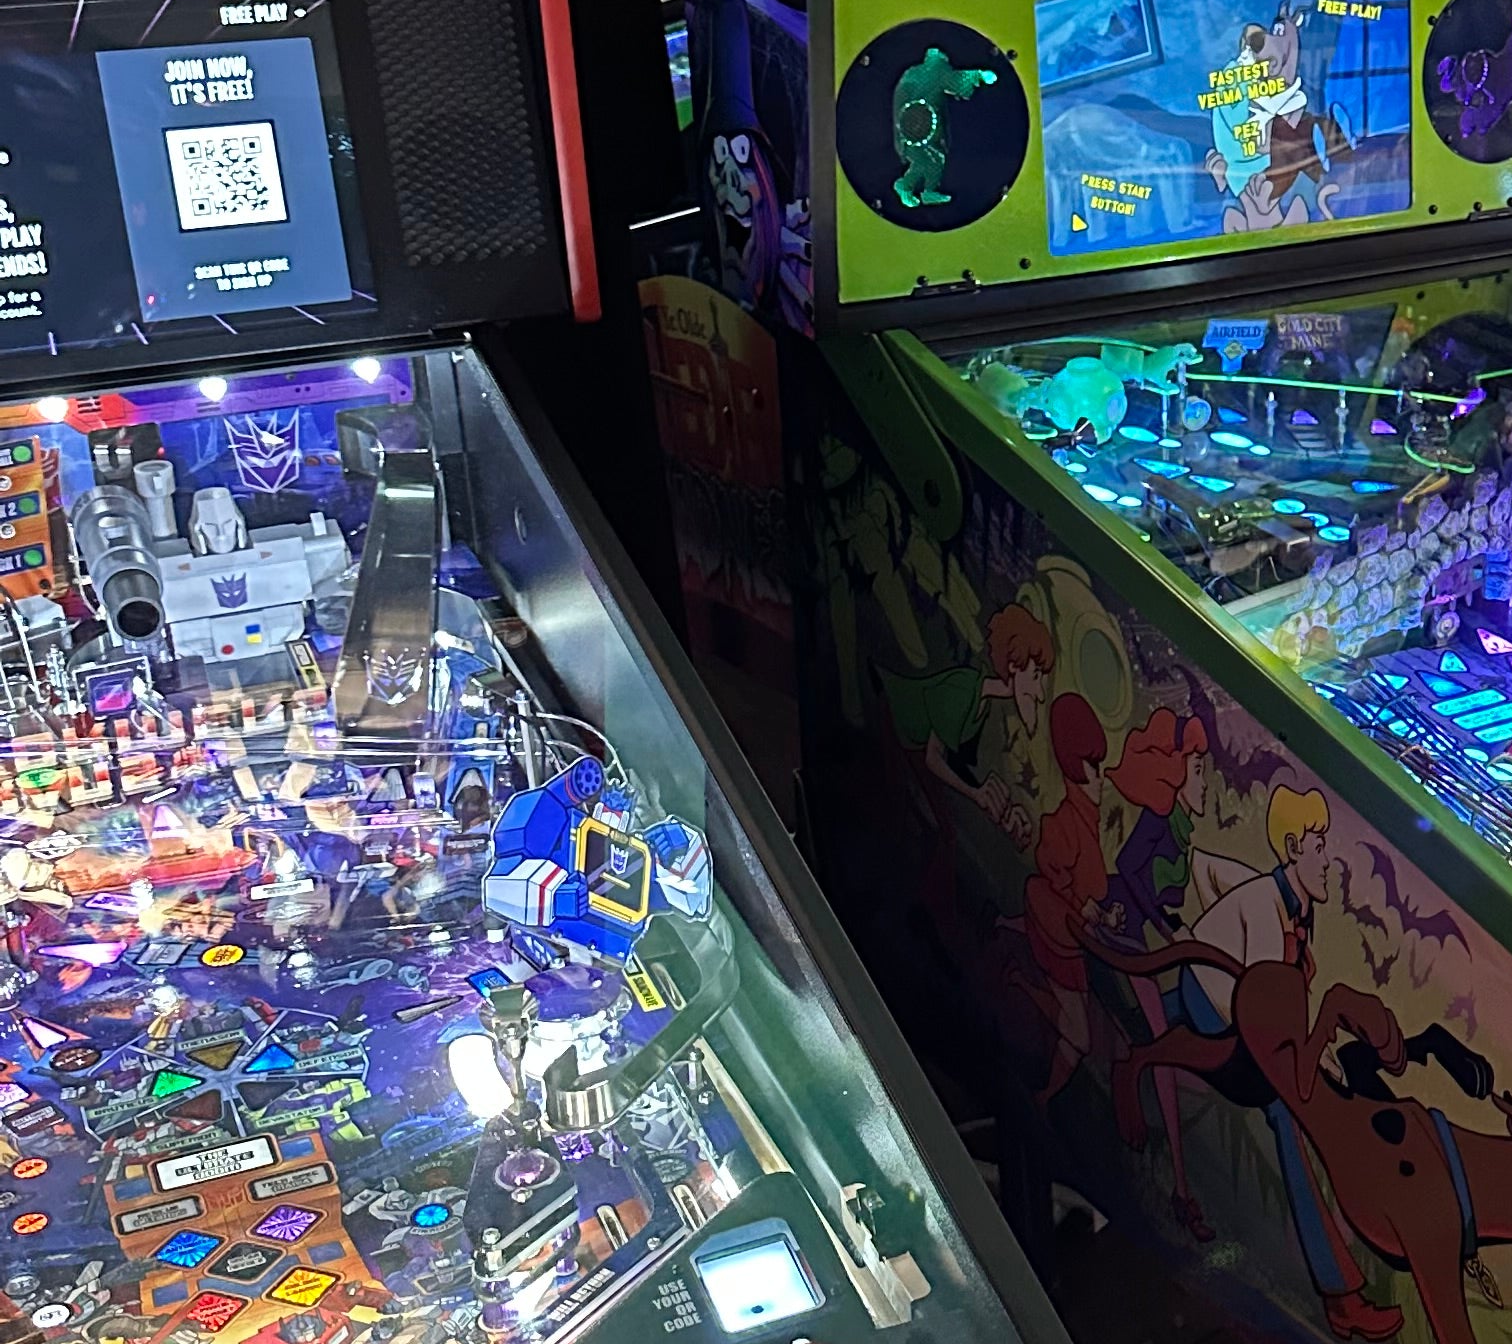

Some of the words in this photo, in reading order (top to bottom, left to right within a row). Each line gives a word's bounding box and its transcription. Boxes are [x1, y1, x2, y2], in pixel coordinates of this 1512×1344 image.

[219, 4, 253, 25] FREE
[253, 2, 289, 23] PLAY
[1348, 2, 1383, 21] PLAY!
[164, 59, 205, 83] JOIN
[206, 55, 254, 81] NOW,
[1208, 59, 1270, 88] FASTEST
[170, 83, 206, 106] IT'S
[207, 77, 255, 103] FREE!
[1197, 84, 1246, 111] VELMA
[1246, 77, 1286, 101] MODE
[1232, 121, 1260, 140] PEZ
[1240, 140, 1257, 157] 10
[1080, 173, 1117, 193] PRESS
[1117, 181, 1153, 200] START
[1090, 196, 1137, 216] BUTTON!
[0, 223, 42, 249] PLAY
[195, 264, 222, 280] SCAN
[223, 261, 247, 277] THIS
[248, 260, 263, 275] QR
[263, 258, 290, 273] CODE
[216, 277, 231, 291] TO
[232, 275, 256, 290] SIGN
[257, 273, 273, 287] UP
[7, 291, 31, 305] for
[32, 292, 42, 303] a
[678, 307, 708, 339] Olde
[1211, 325, 1262, 339] AIRFIELD
[1314, 317, 1343, 332] CITY
[1290, 334, 1333, 350] MINE
[180, 1030, 243, 1049] MENASOR
[92, 1097, 155, 1117] BRUTICUS
[658, 1278, 688, 1297] USE
[652, 1290, 692, 1311] YOUR
[675, 1301, 698, 1317] QR
[663, 1311, 703, 1334] CODE
